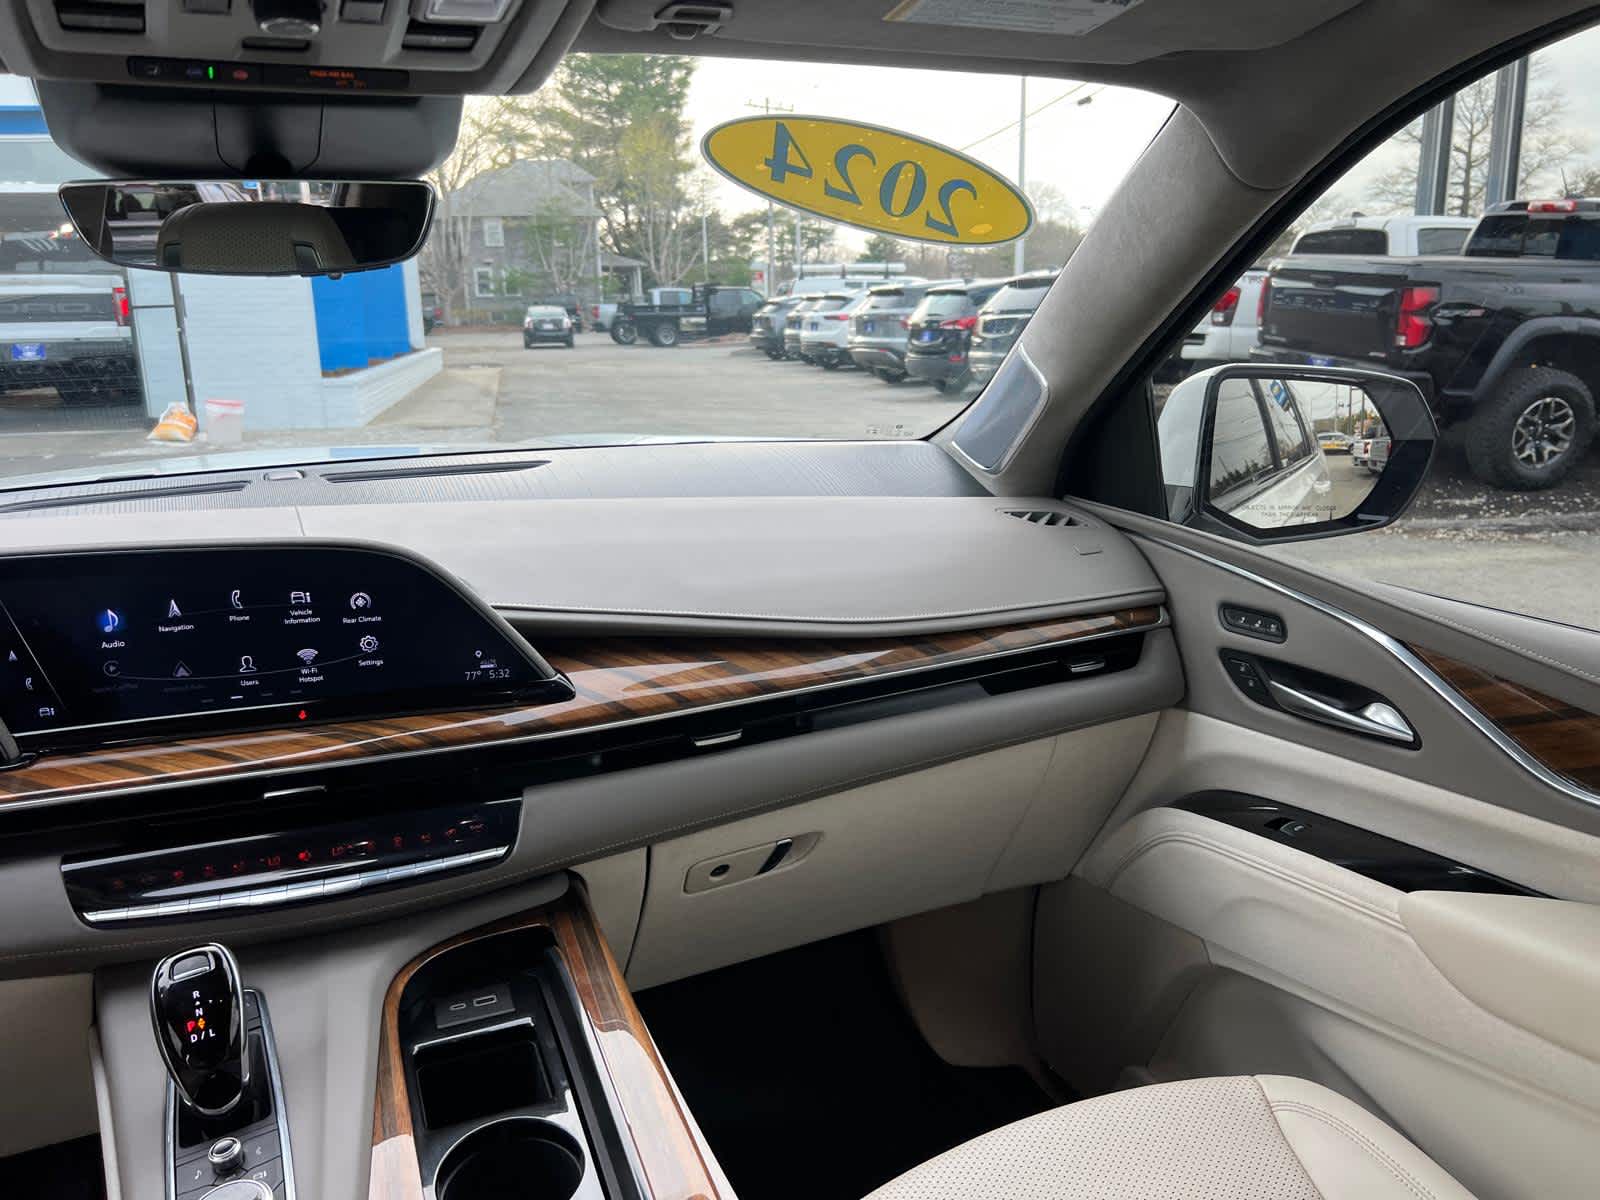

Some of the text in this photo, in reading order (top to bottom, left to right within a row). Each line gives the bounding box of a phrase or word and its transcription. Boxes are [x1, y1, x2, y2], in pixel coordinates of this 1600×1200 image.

[289, 608, 313, 616] Vehicle
[229, 614, 250, 622] Phone
[284, 616, 321, 625] Information
[358, 615, 382, 623] Climate
[158, 624, 195, 633] Navigation
[101, 640, 126, 649] Audio
[358, 658, 384, 668] Settings
[301, 667, 318, 675] Wi-Fi
[464, 668, 511, 681] 77° 5:32
[240, 679, 260, 687] Users
[298, 674, 324, 684] Hotspot
[192, 990, 201, 999] R
[195, 1007, 204, 1017] N
